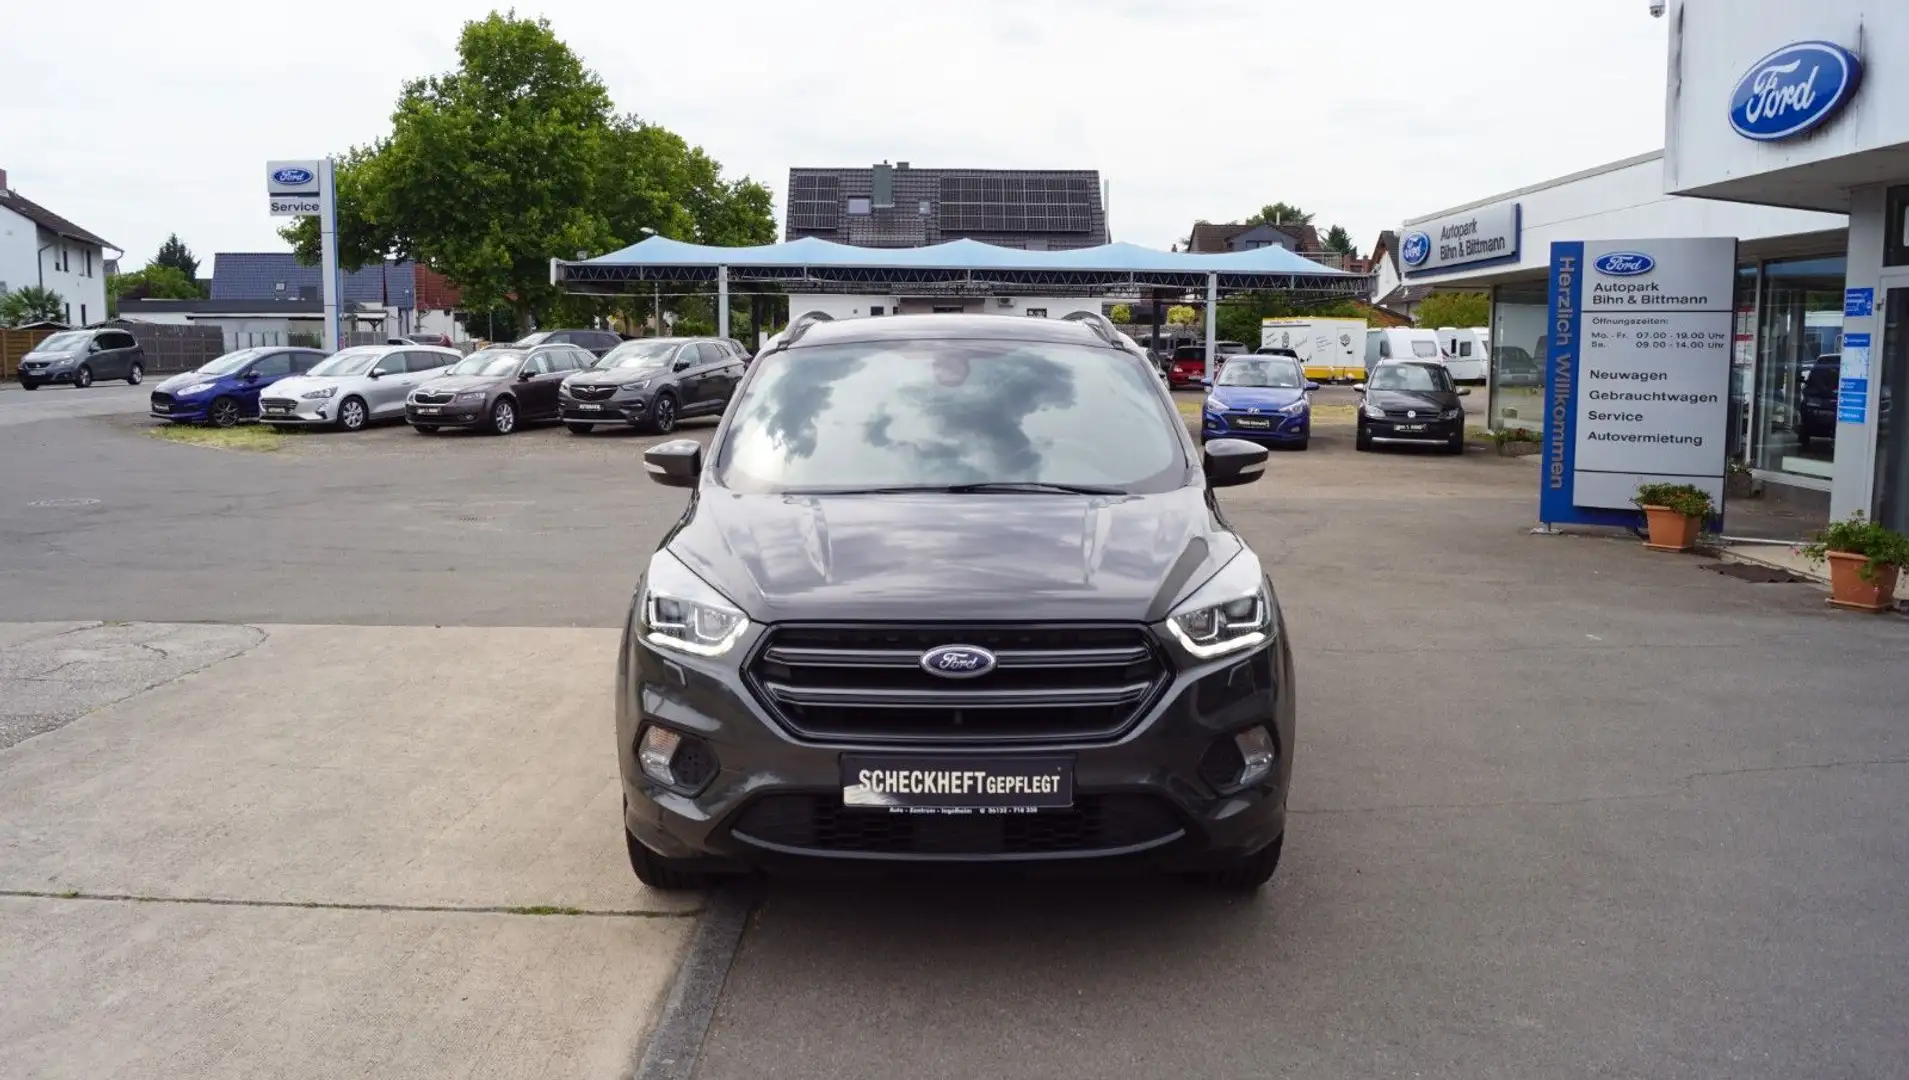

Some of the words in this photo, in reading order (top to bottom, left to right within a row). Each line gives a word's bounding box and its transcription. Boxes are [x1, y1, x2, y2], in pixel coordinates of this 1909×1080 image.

[1746, 58, 1819, 123] Ford
[279, 170, 304, 181] Ford
[271, 201, 320, 212] Service
[1440, 218, 1478, 240] Autopark
[1440, 245, 1457, 260] Bihn
[1459, 241, 1464, 257] &
[1466, 236, 1506, 256] Bittmann
[1606, 255, 1642, 271] Ford
[1593, 282, 1660, 293] Autopark
[1556, 256, 1575, 346] Herzlich
[1592, 295, 1624, 305] Bihn
[1627, 295, 1637, 305] &
[1641, 295, 1708, 306] Bittmann
[1592, 316, 1669, 326] Öffnungszeiten:
[1708, 332, 1725, 340] Uhr
[1589, 369, 1668, 382] Neuwagen
[1589, 390, 1718, 404] Gebrauchtwagen
[1551, 354, 1572, 489] Willkommen
[1588, 410, 1644, 422] Service
[1588, 431, 1703, 446] Autovermietung
[939, 652, 978, 669] Ford
